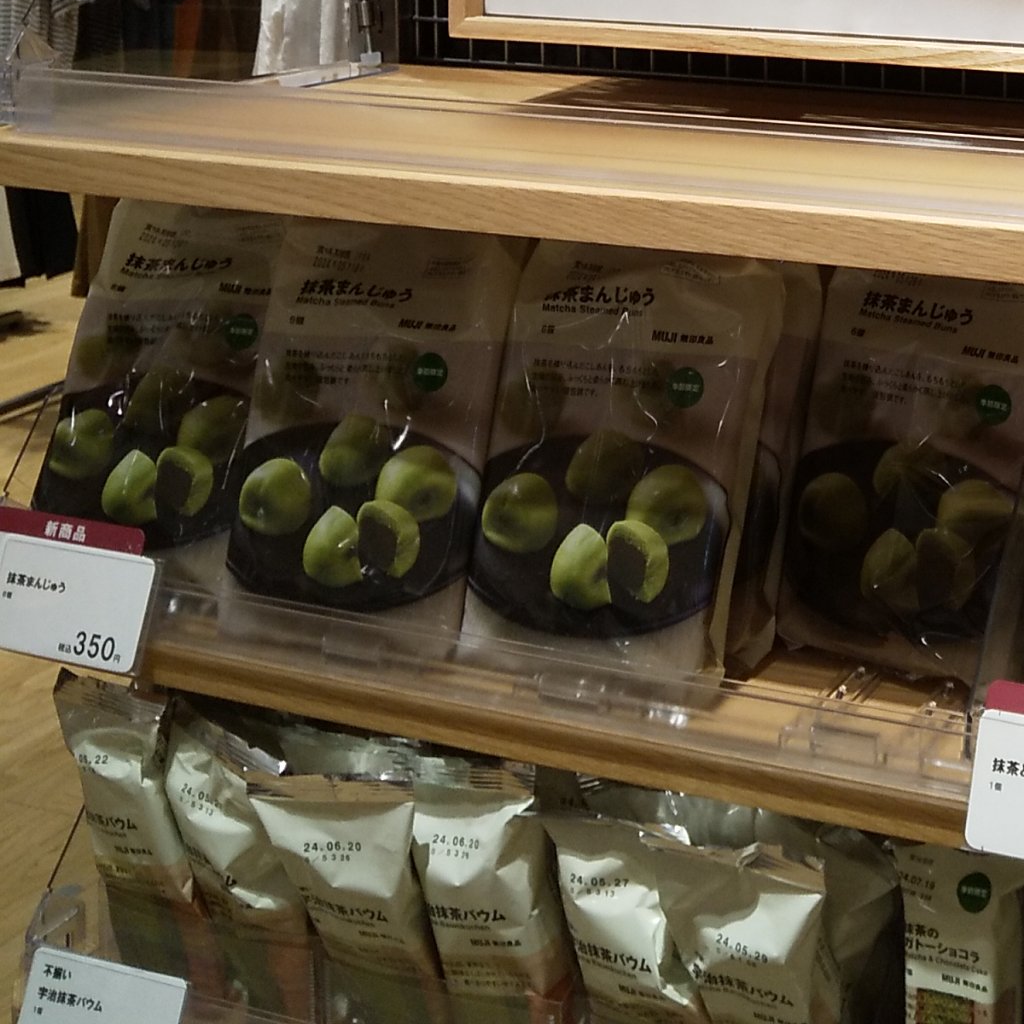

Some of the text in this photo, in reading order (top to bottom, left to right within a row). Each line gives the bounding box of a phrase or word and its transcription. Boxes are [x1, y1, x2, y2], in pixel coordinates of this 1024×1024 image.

[542, 303, 577, 314] Matcha
[863, 290, 974, 326] 抹茶まんじゅう
[652, 329, 678, 343] MUJI
[962, 345, 987, 359] MUJI
[44, 519, 87, 543] 新商品
[6, 571, 66, 594] 抹茶まんじゅう
[303, 841, 362, 853] 24.06.20
[432, 833, 480, 850] 24.06.20
[575, 941, 652, 973] 治抹茶バウム
[904, 938, 980, 964] ガトーショコラ
[37, 985, 103, 1012] 宇治抹茶バウム
